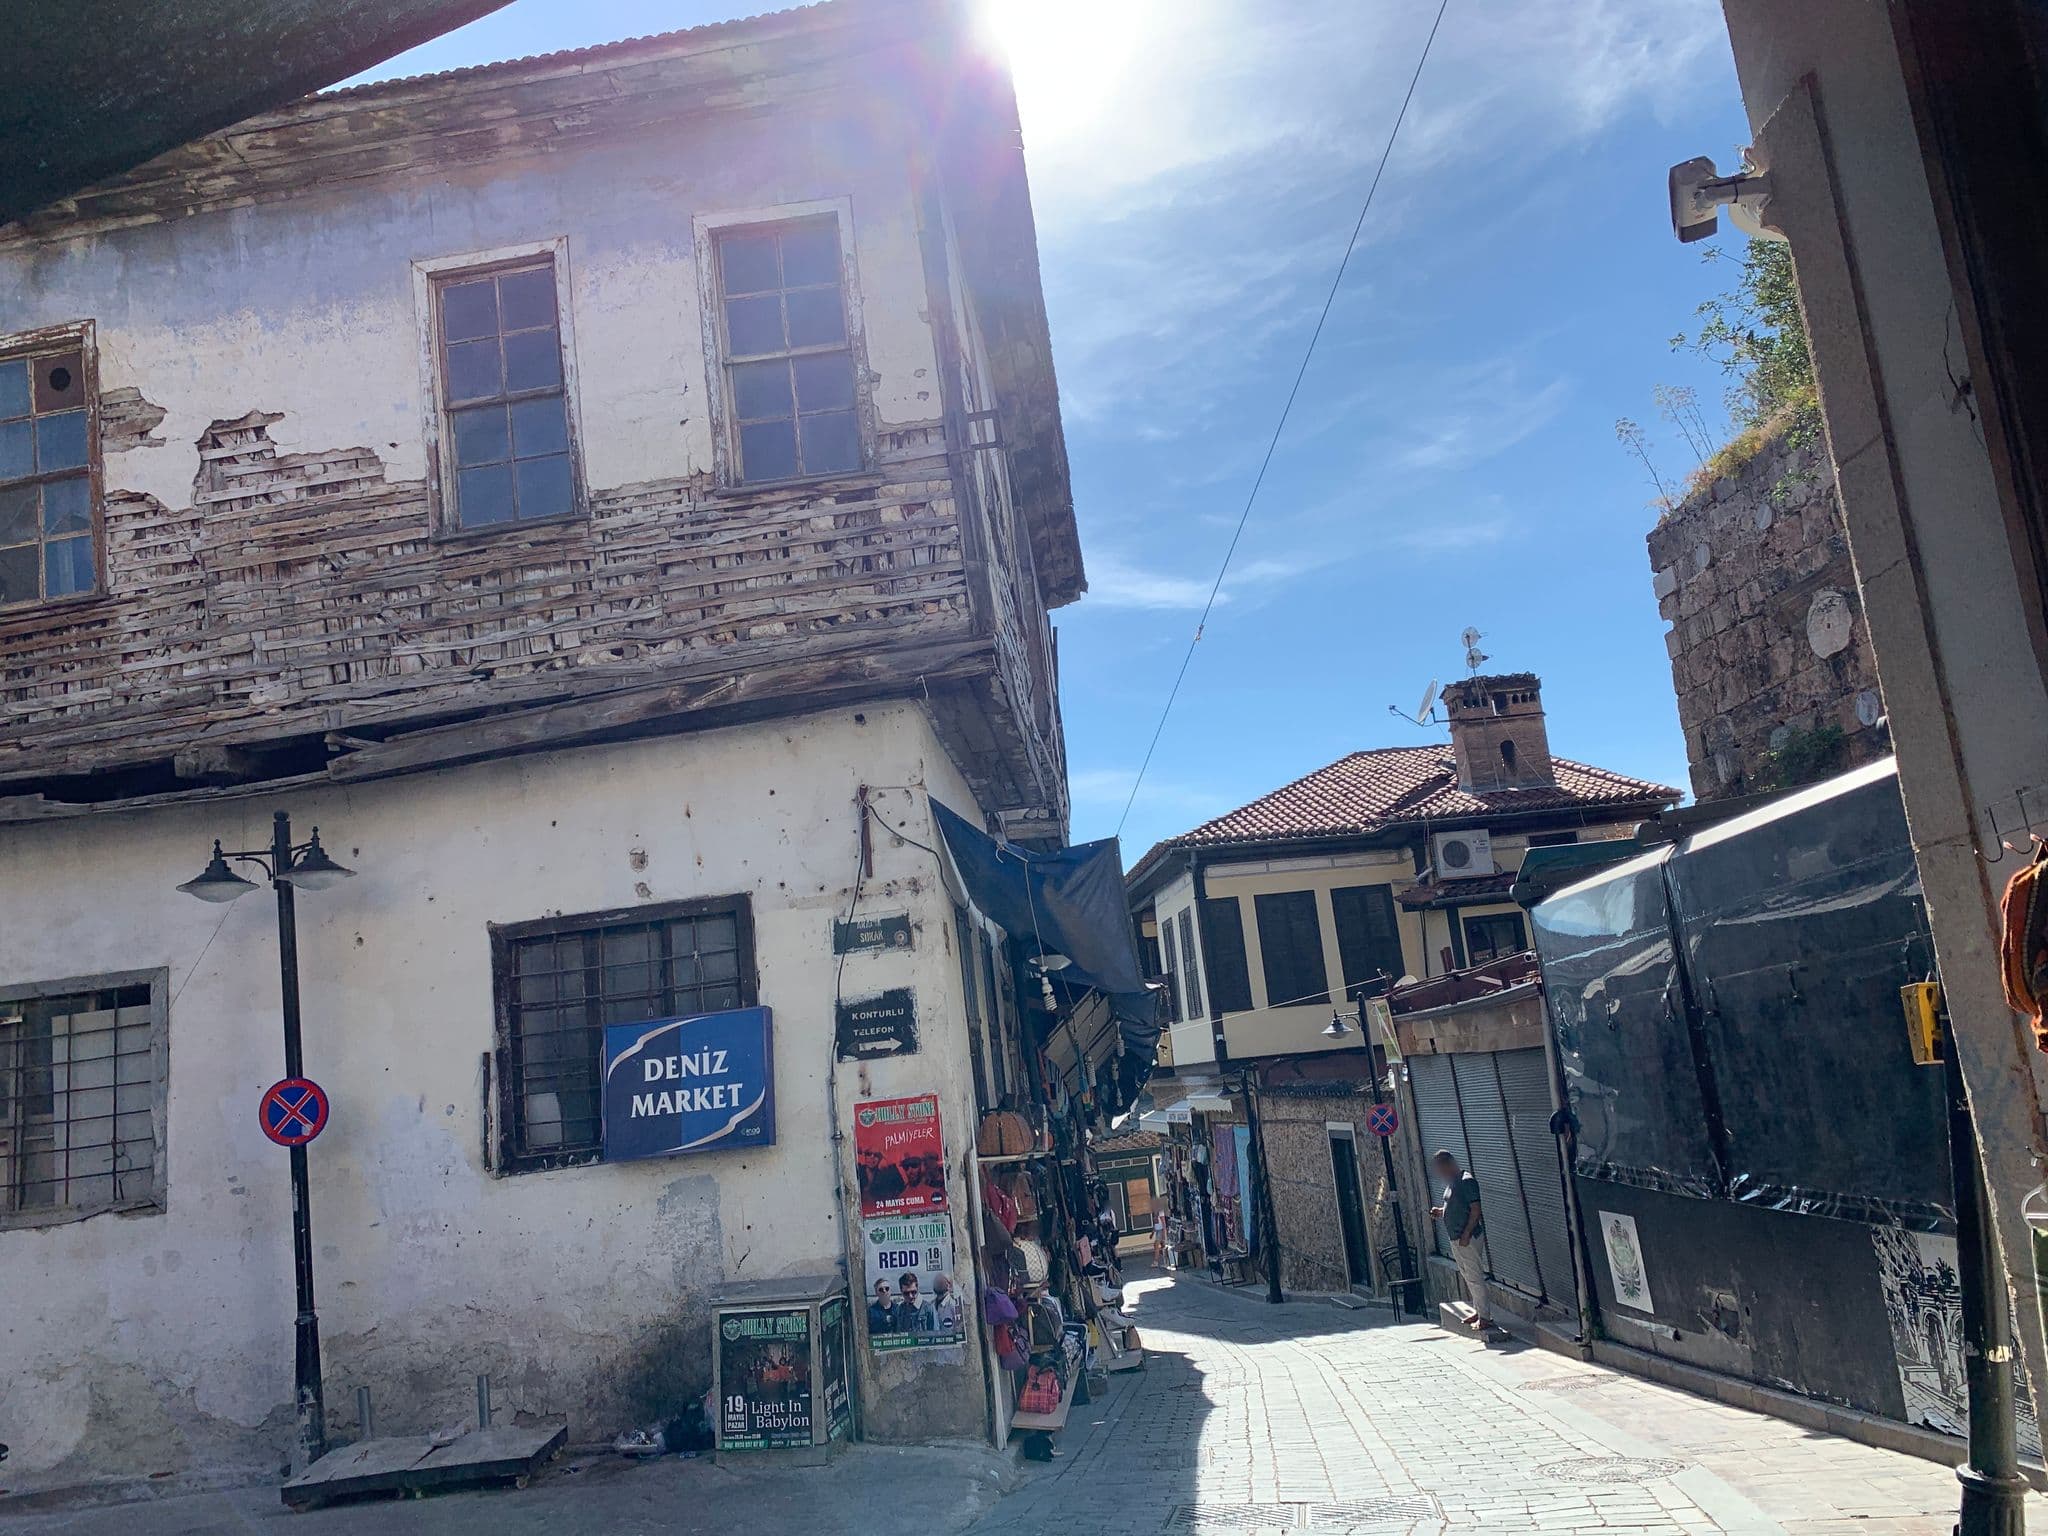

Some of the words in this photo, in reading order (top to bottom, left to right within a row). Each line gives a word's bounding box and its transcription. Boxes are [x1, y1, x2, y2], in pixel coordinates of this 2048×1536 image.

[853, 1026, 894, 1036] TELEFON
[644, 1045, 729, 1082] DENİZ
[630, 1083, 743, 1118] MARKET
[876, 1201, 884, 1209] 24
[885, 1198, 905, 1207] MAYIS
[906, 1196, 924, 1205] CUMA
[886, 1225, 915, 1241] HOLLY
[919, 1223, 947, 1239] STONE
[879, 1250, 919, 1269] REDD
[928, 1247, 940, 1259] 18
[741, 1317, 774, 1336] HOLLY
[776, 1316, 807, 1333] STONE
[726, 1395, 744, 1413] 19
[752, 1401, 785, 1417] Light
[789, 1399, 802, 1412] In
[727, 1421, 746, 1429] PAZAR
[756, 1413, 810, 1430] Babylon
